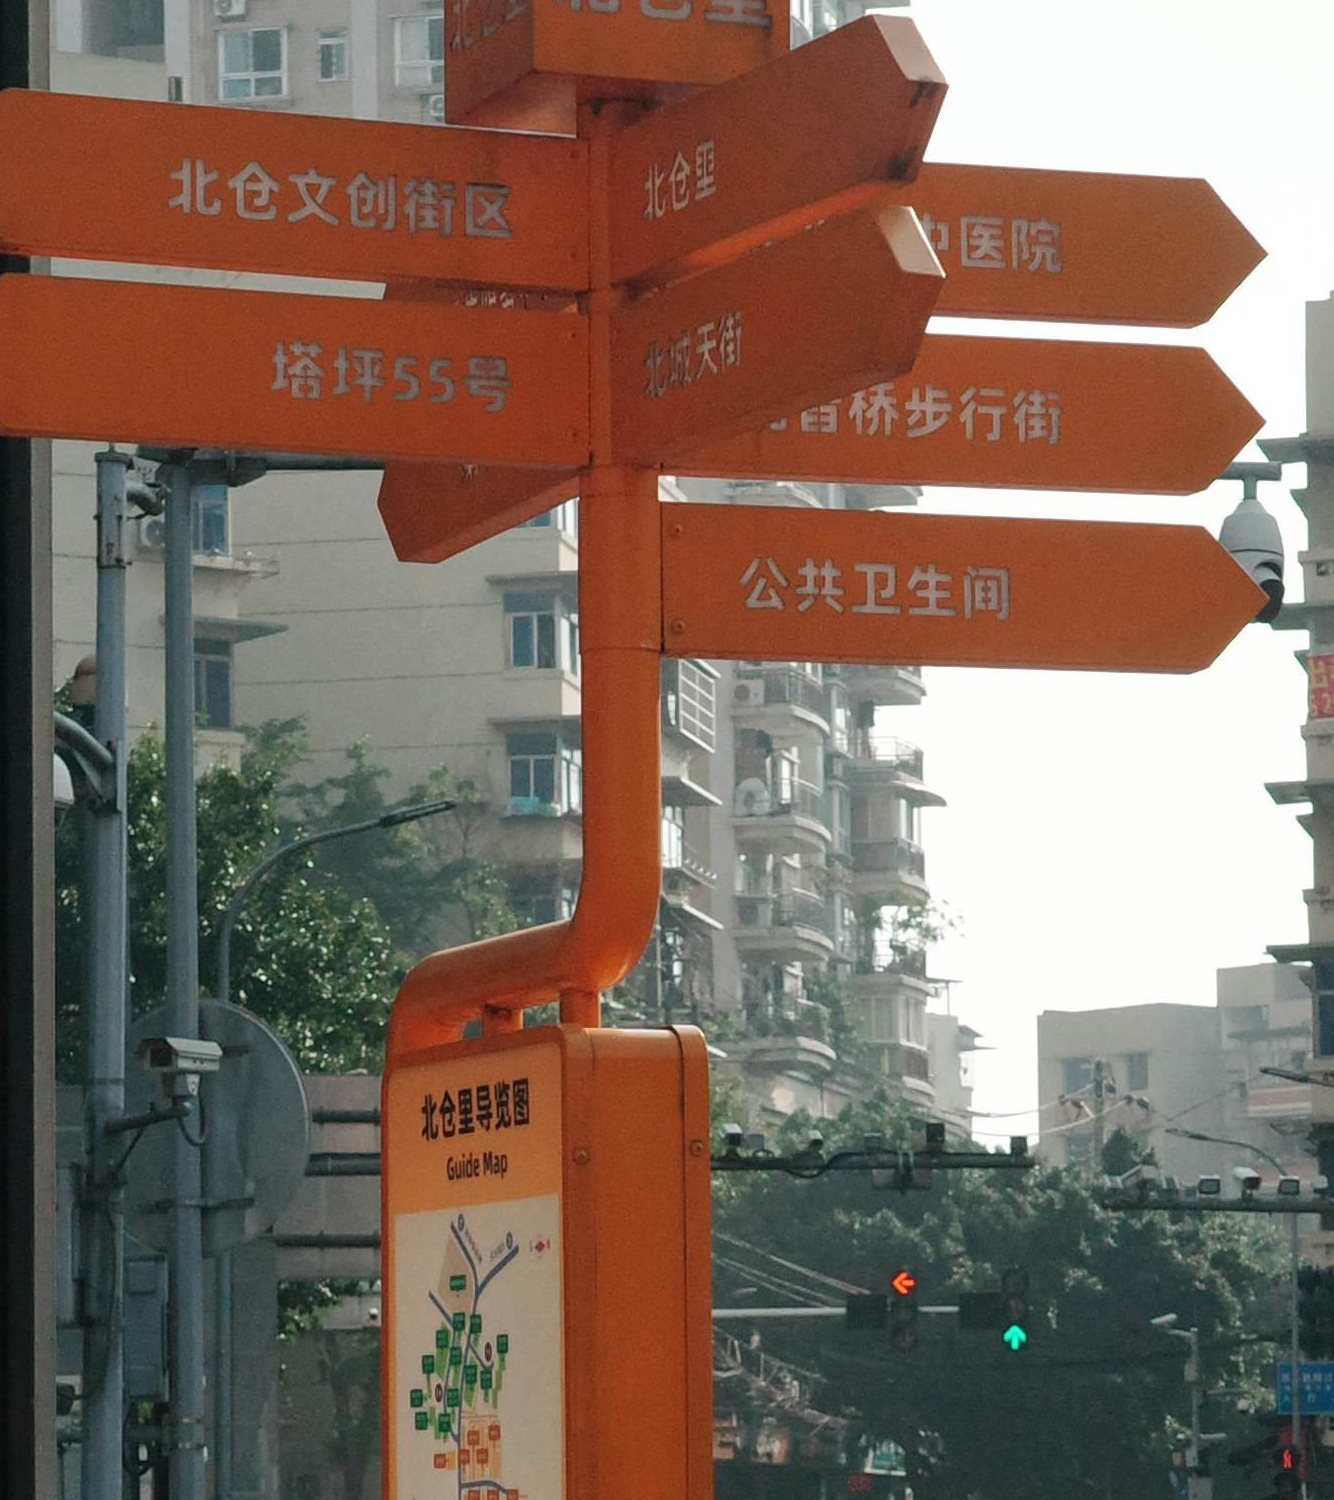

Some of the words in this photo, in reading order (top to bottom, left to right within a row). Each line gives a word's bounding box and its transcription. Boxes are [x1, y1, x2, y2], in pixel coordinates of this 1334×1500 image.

[168, 156, 514, 238] 北仓文创街区
[643, 137, 717, 220] 北仓里
[270, 339, 514, 413] 塔坪55号
[643, 311, 743, 398] 北城天街
[739, 556, 1011, 621] 公共卫生间
[421, 1078, 530, 1141] 北仓里导览图
[447, 1152, 480, 1181] Guide
[483, 1151, 508, 1180] Map
